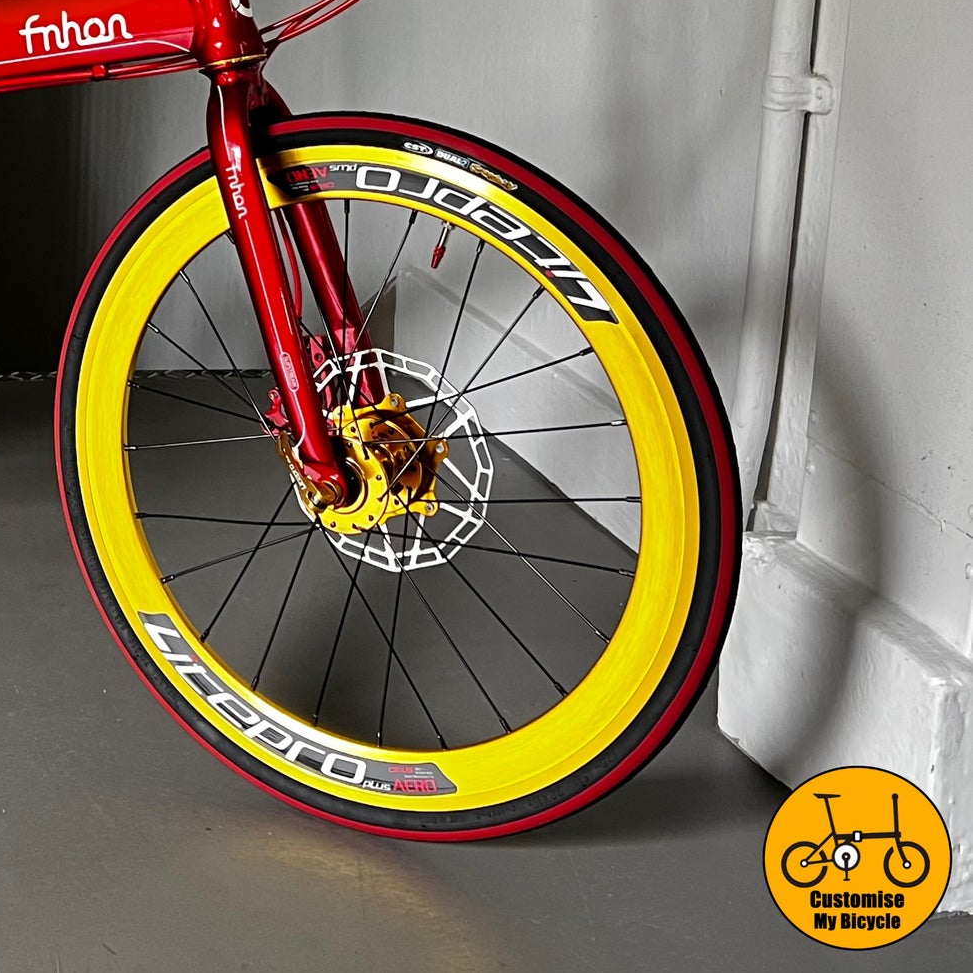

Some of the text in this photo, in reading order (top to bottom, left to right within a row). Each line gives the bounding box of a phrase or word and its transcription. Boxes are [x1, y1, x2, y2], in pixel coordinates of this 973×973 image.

[19, 11, 133, 55] fnhon
[361, 779, 391, 792] plus
[393, 778, 438, 793] AERO
